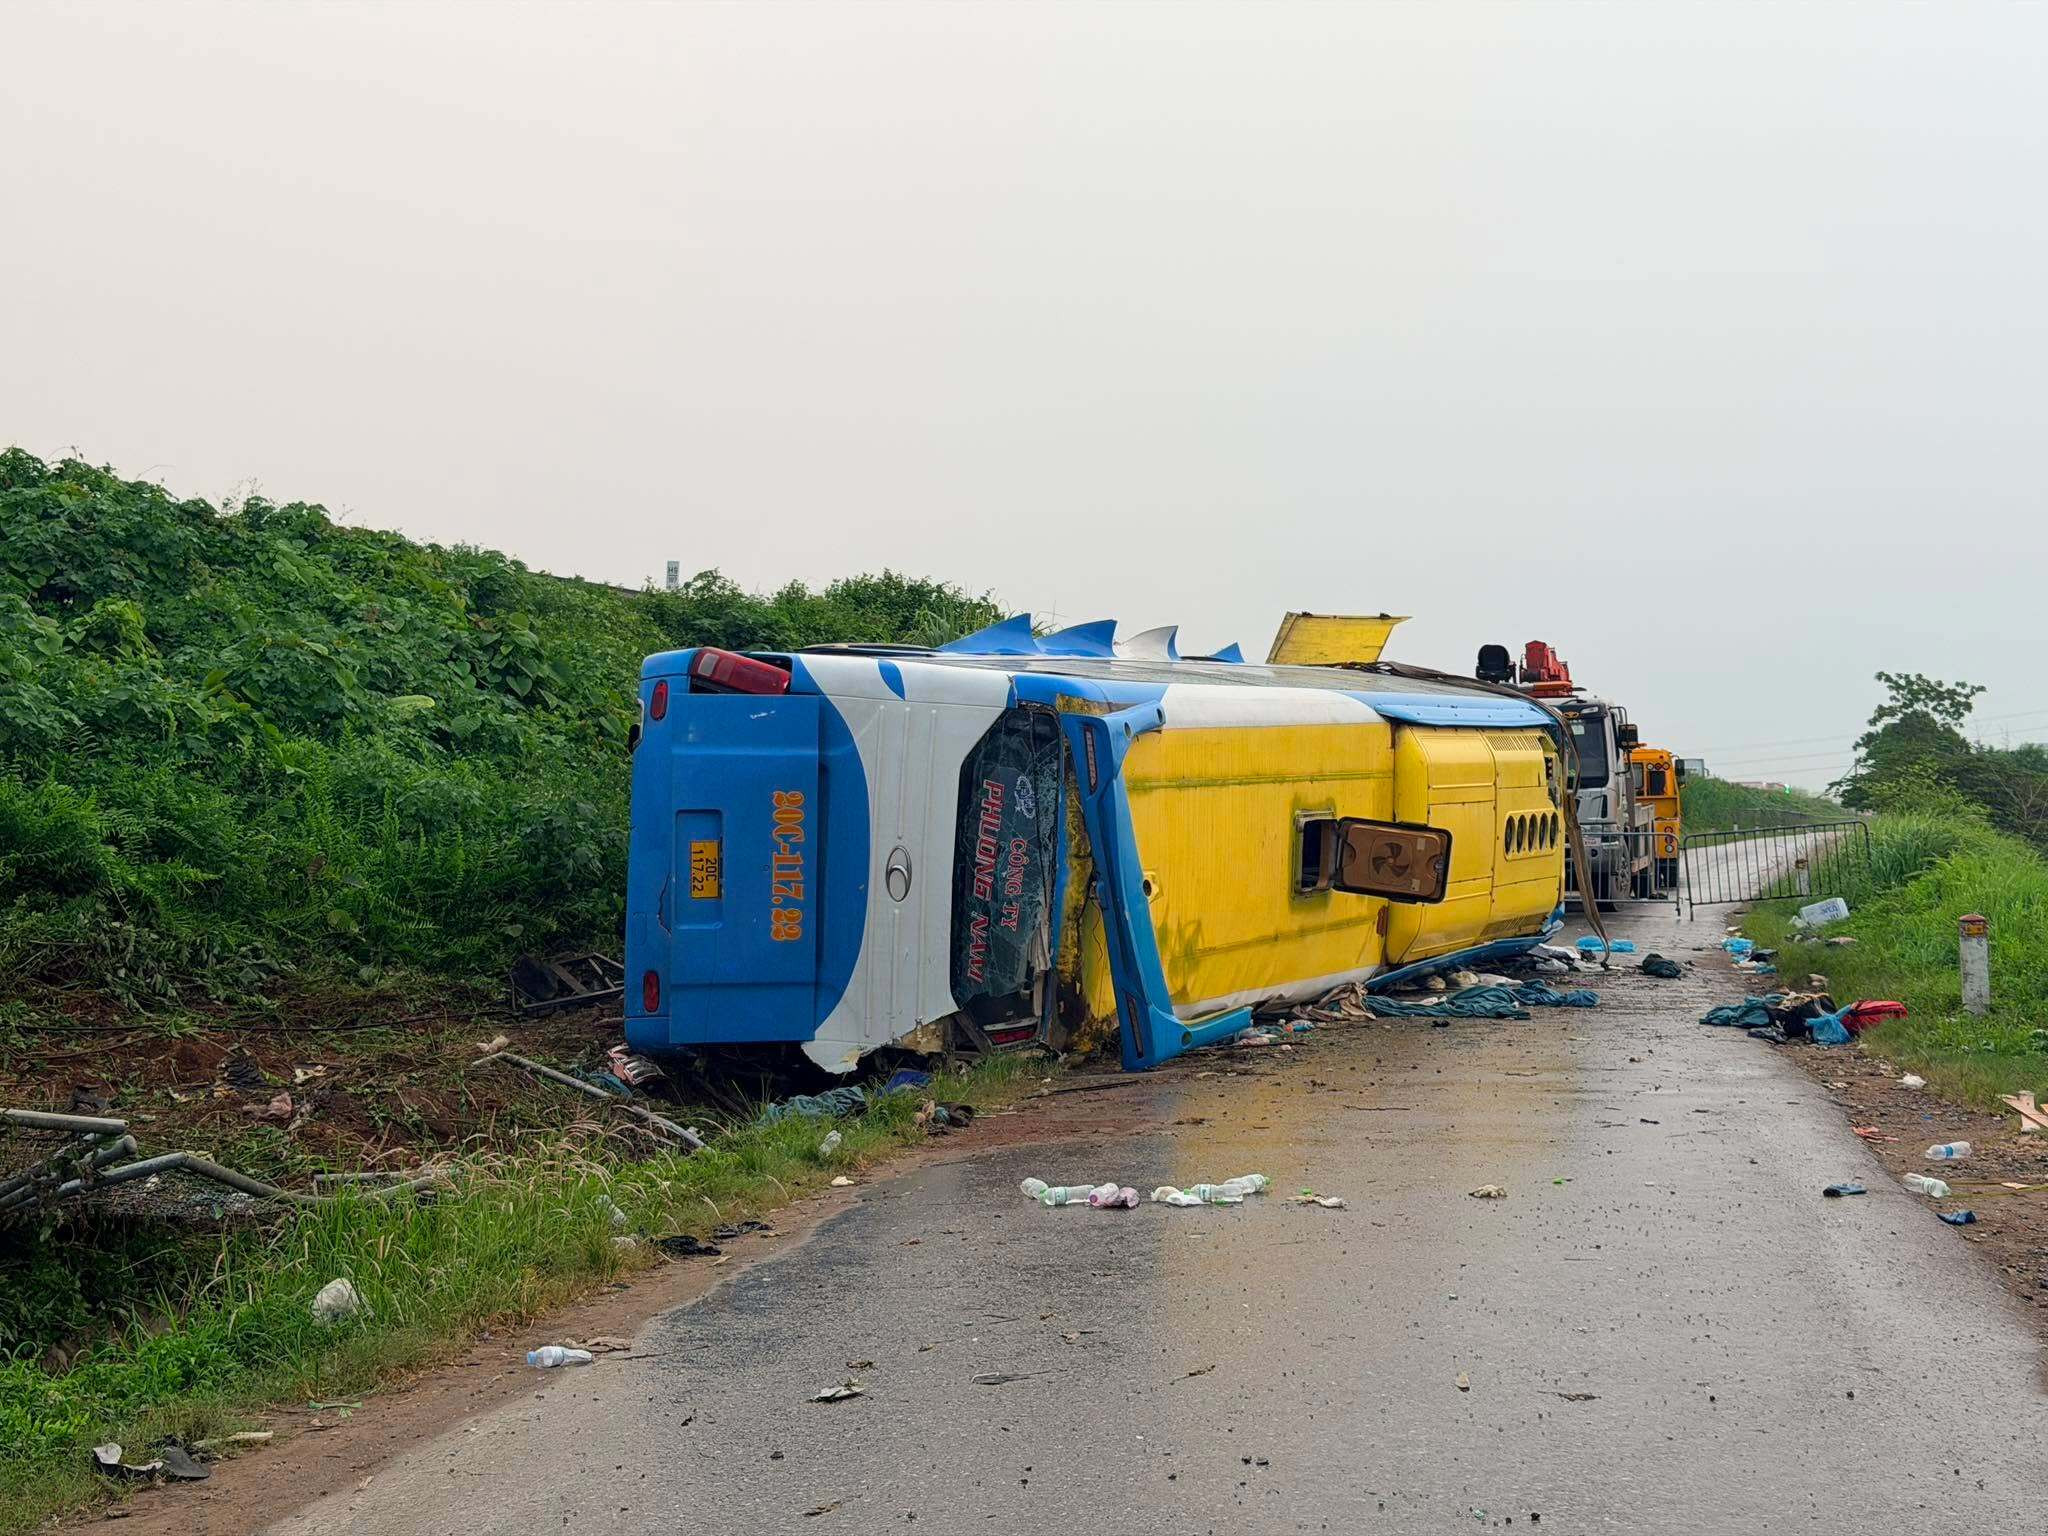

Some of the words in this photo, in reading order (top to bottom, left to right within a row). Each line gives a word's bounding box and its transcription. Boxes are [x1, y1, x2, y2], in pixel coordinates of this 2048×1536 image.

[692, 849, 705, 892] 117.22
[705, 857, 718, 881] 20C
[1005, 838, 1029, 895] CÔNG
[1001, 901, 1020, 932] TY
[967, 910, 988, 983] NAM
